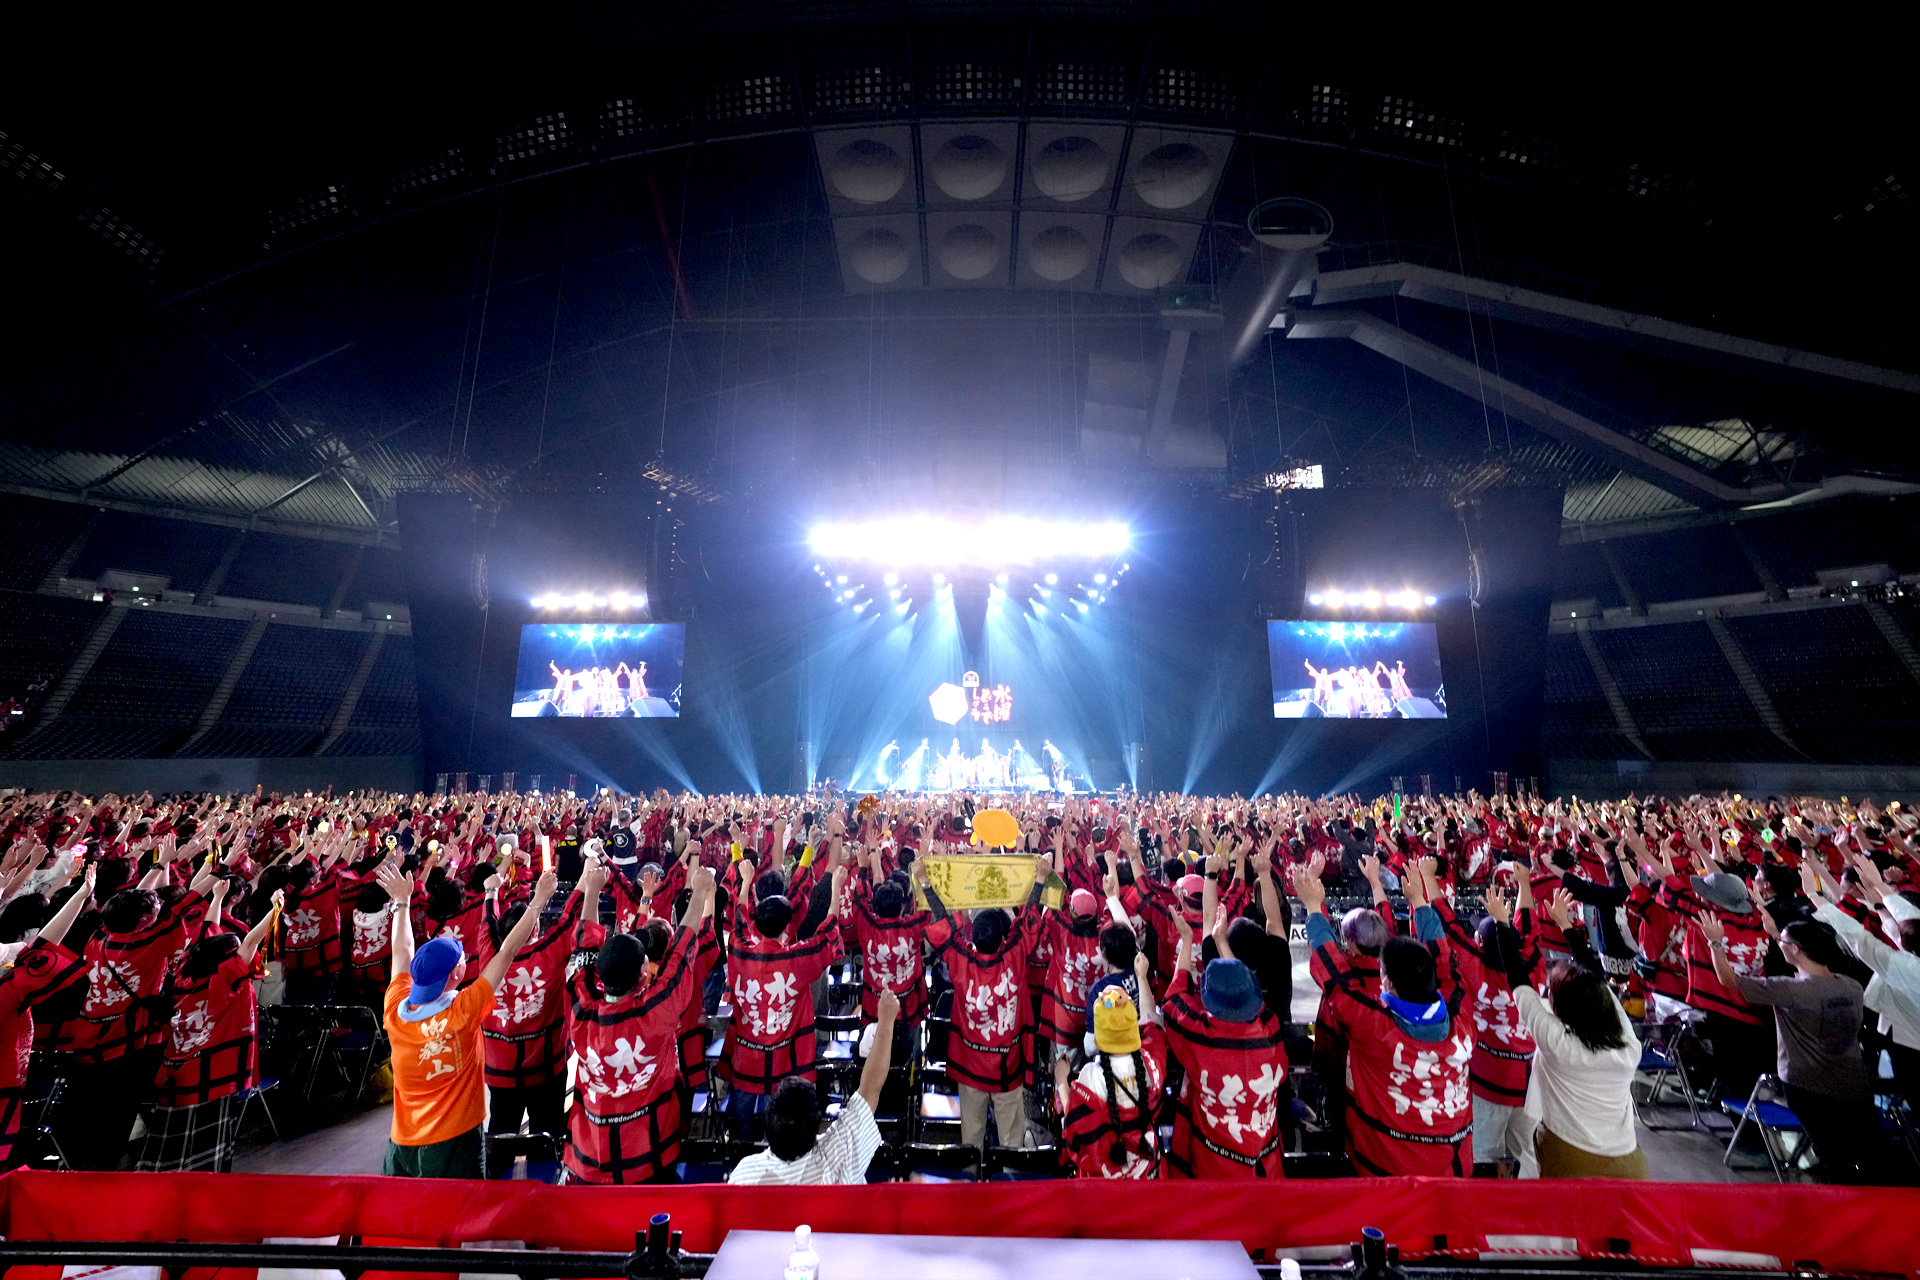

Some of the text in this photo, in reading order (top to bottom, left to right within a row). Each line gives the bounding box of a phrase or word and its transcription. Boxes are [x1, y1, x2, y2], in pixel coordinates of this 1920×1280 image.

[980, 687, 994, 725] どうで
[992, 683, 1013, 722] 水曜
[507, 965, 546, 1024] 水曜
[745, 979, 766, 1036] どうで
[764, 971, 799, 1035] 水曜
[965, 978, 977, 1030] しょう
[976, 984, 998, 1041] どうで
[994, 967, 1018, 1036] 水曜
[604, 1035, 657, 1098] 水曜
[1388, 1042, 1412, 1115] しょう
[1413, 1050, 1443, 1126] どうで
[1445, 1034, 1472, 1119] 水曜
[1200, 1069, 1219, 1129] しょう
[1218, 1074, 1251, 1144] どうで
[1249, 1063, 1284, 1138] 水曜
[1205, 1138, 1219, 1152] How
[1219, 1148, 1229, 1156] do
[1230, 1152, 1243, 1162] you
